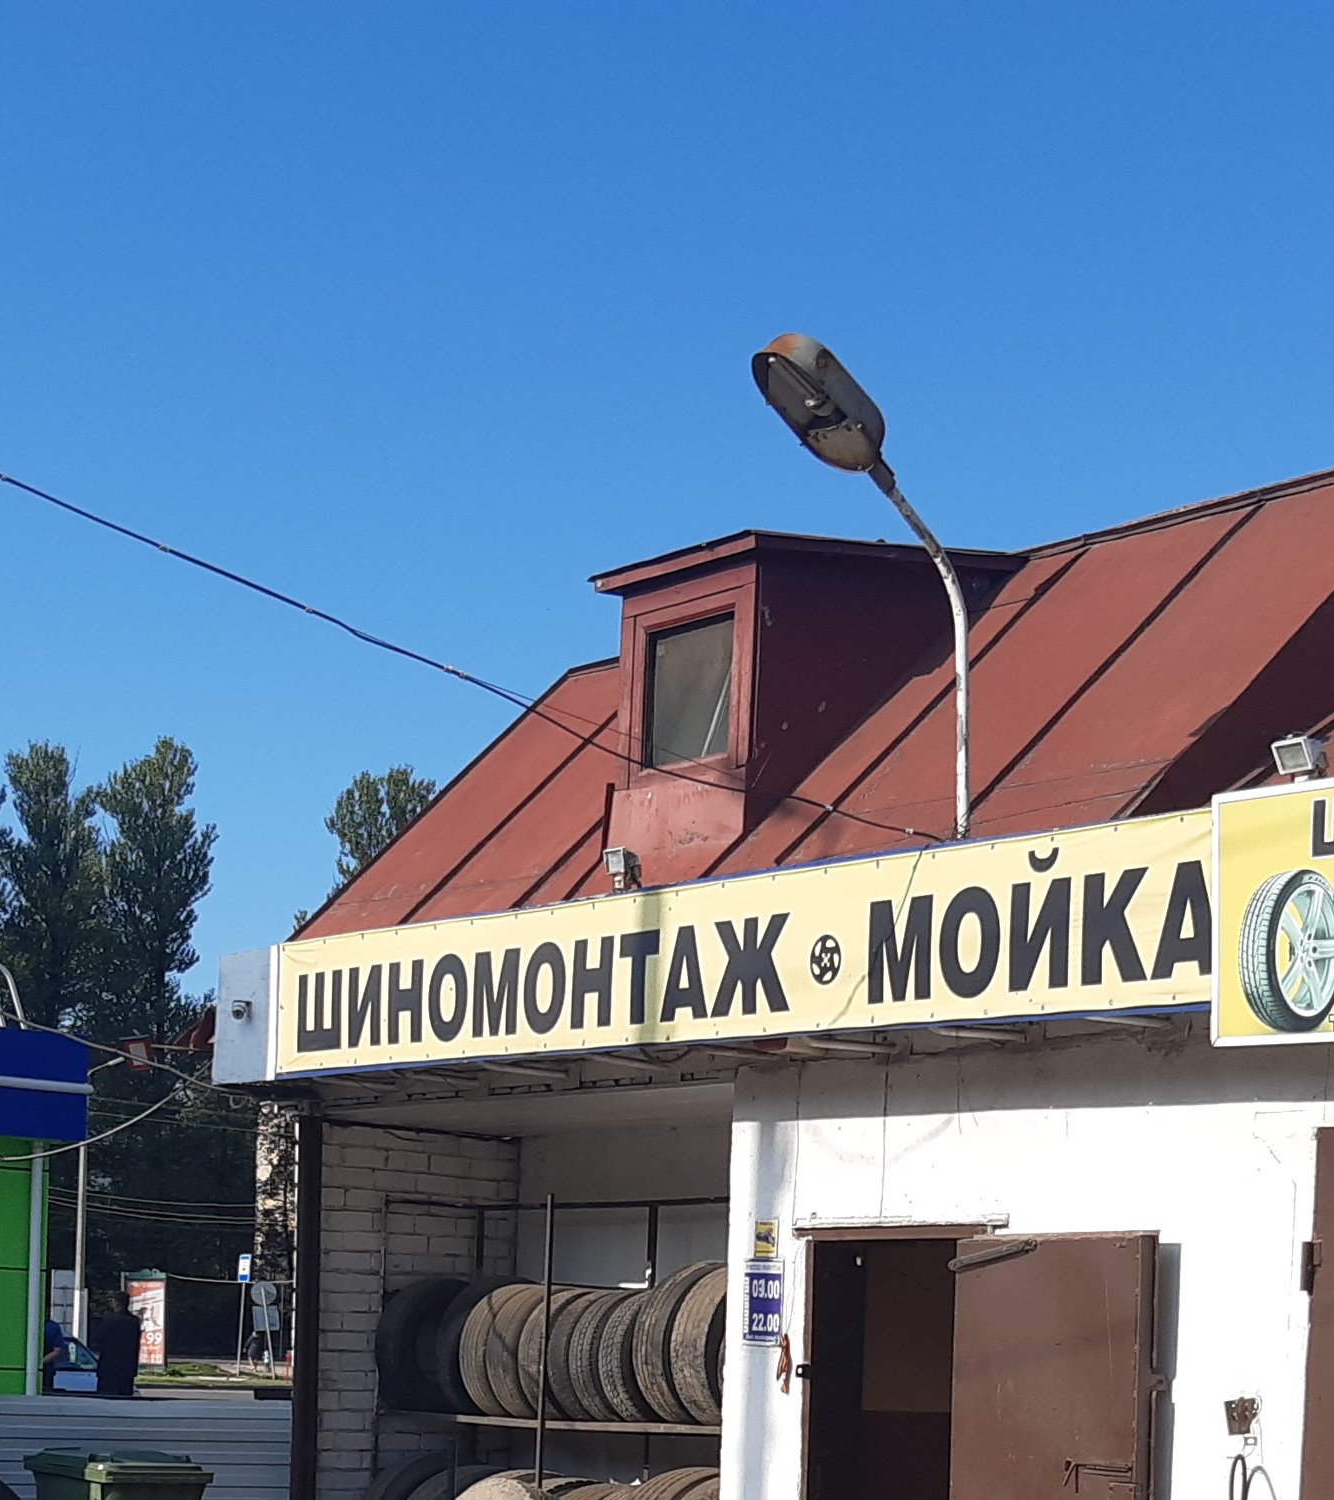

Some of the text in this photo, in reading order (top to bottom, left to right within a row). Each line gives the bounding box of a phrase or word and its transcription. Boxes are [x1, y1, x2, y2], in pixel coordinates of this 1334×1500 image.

[296, 846, 1213, 1053] ШИНОМОНТАЖ МОЙКА
[751, 1312, 781, 1333] 22.00
